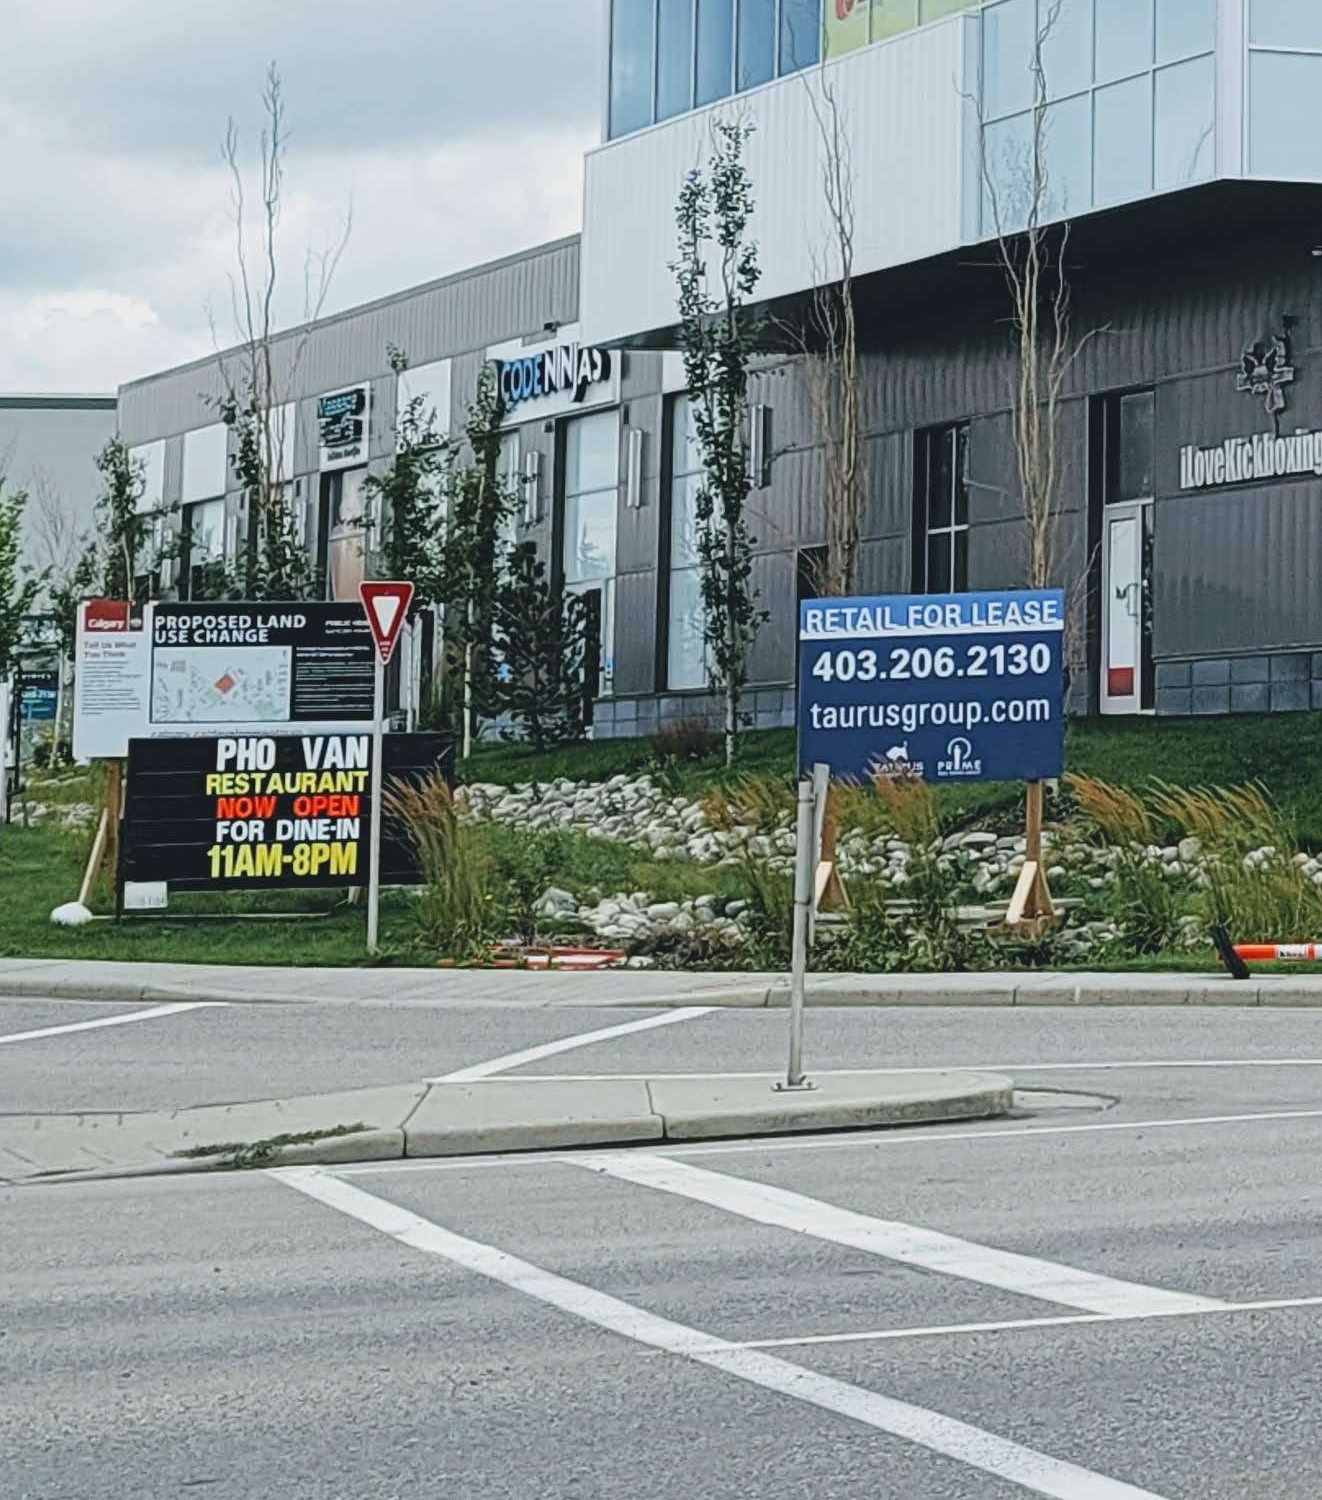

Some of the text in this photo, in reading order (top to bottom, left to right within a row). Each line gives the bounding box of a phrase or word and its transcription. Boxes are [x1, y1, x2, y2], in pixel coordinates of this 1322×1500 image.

[154, 614, 307, 630] PROPOSED LAND
[805, 600, 1058, 634] RETAIL FOR LEASE
[154, 629, 269, 644] USE CHANGE
[812, 642, 1051, 682] 403.206.2130
[810, 698, 1051, 732] taurusgroup.com
[216, 736, 369, 772] PHO VAN
[206, 771, 369, 795] RESTAURANT
[216, 795, 359, 819] NOW OPEN
[216, 817, 360, 843] FOR DINE-IN
[207, 841, 358, 878] 11AM-8PM
